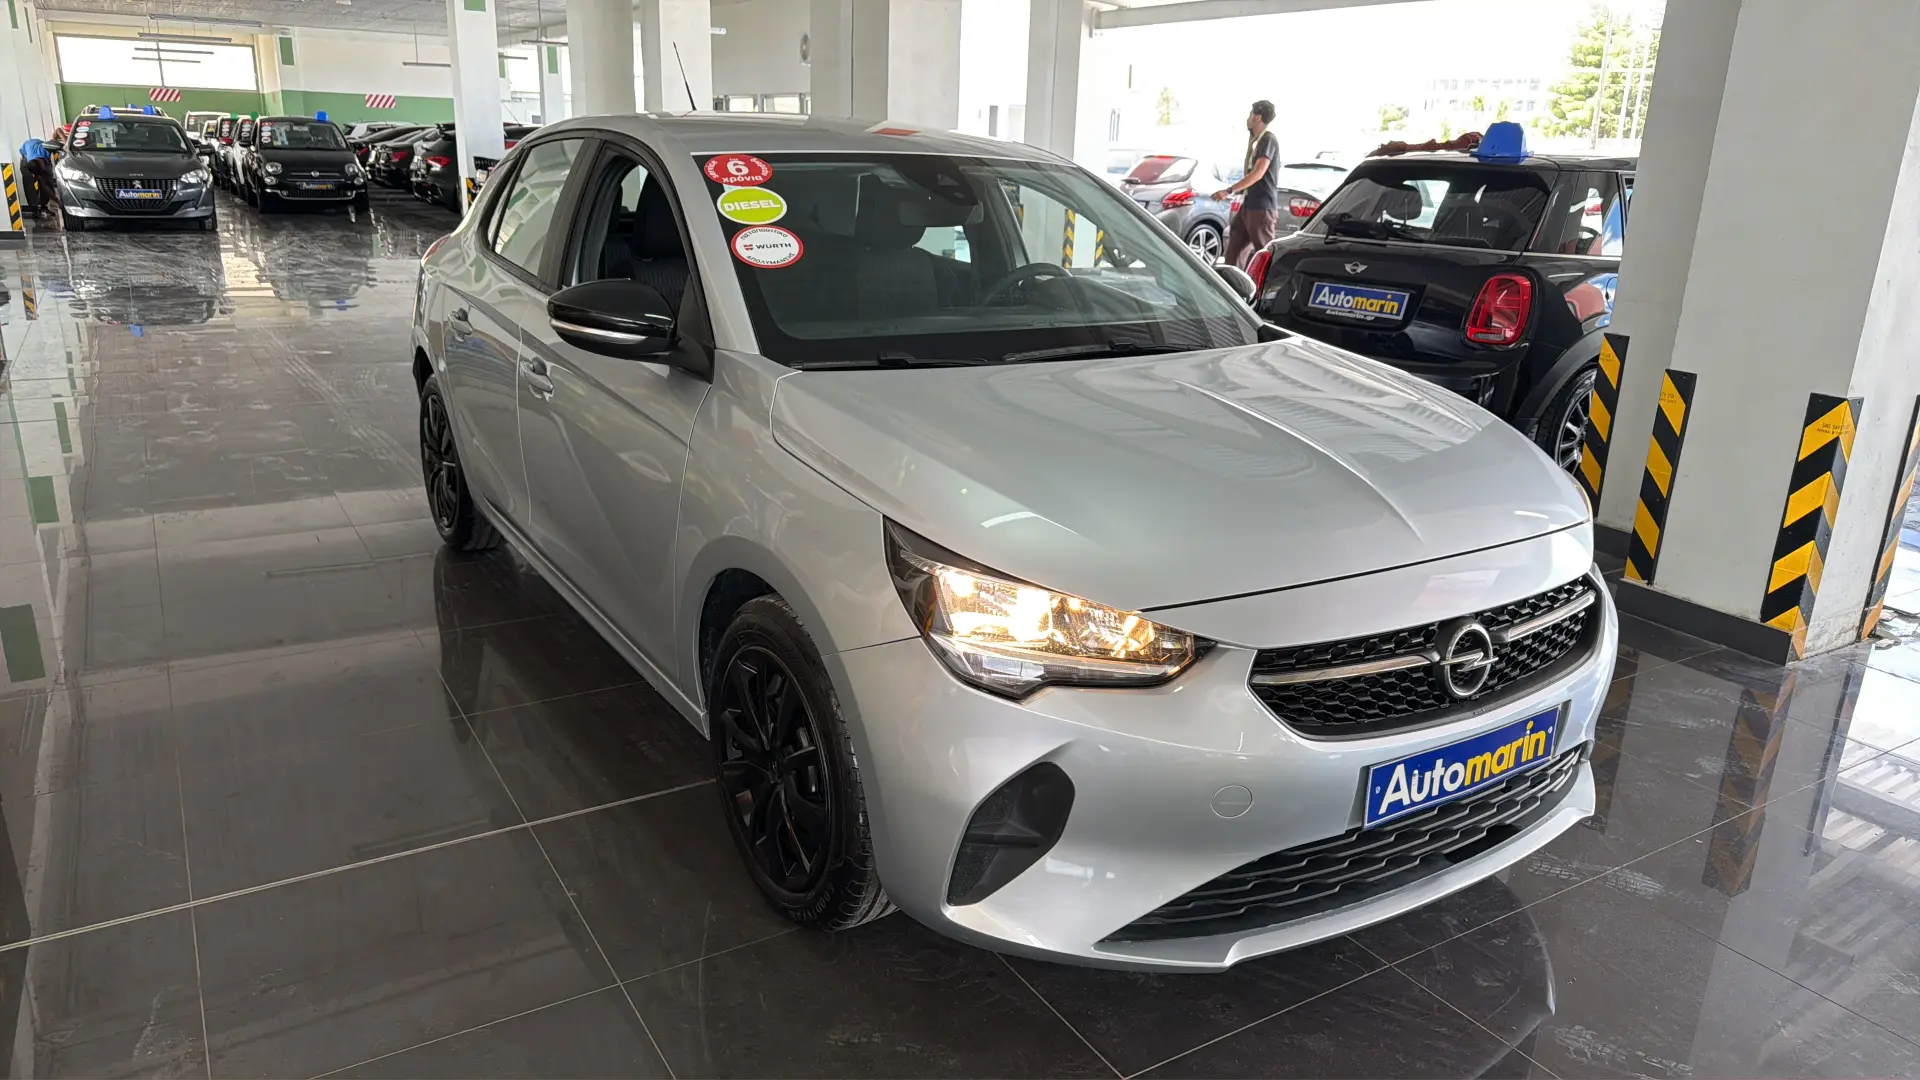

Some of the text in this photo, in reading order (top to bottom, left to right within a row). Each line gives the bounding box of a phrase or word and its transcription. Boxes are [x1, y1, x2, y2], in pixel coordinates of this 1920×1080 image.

[726, 160, 749, 176] 6
[722, 175, 763, 183] χρόνια
[723, 199, 781, 212] DIESEL
[1315, 286, 1400, 315] Automarin
[1325, 309, 1376, 321] Automarin.gr
[1378, 720, 1547, 815] Automarin
